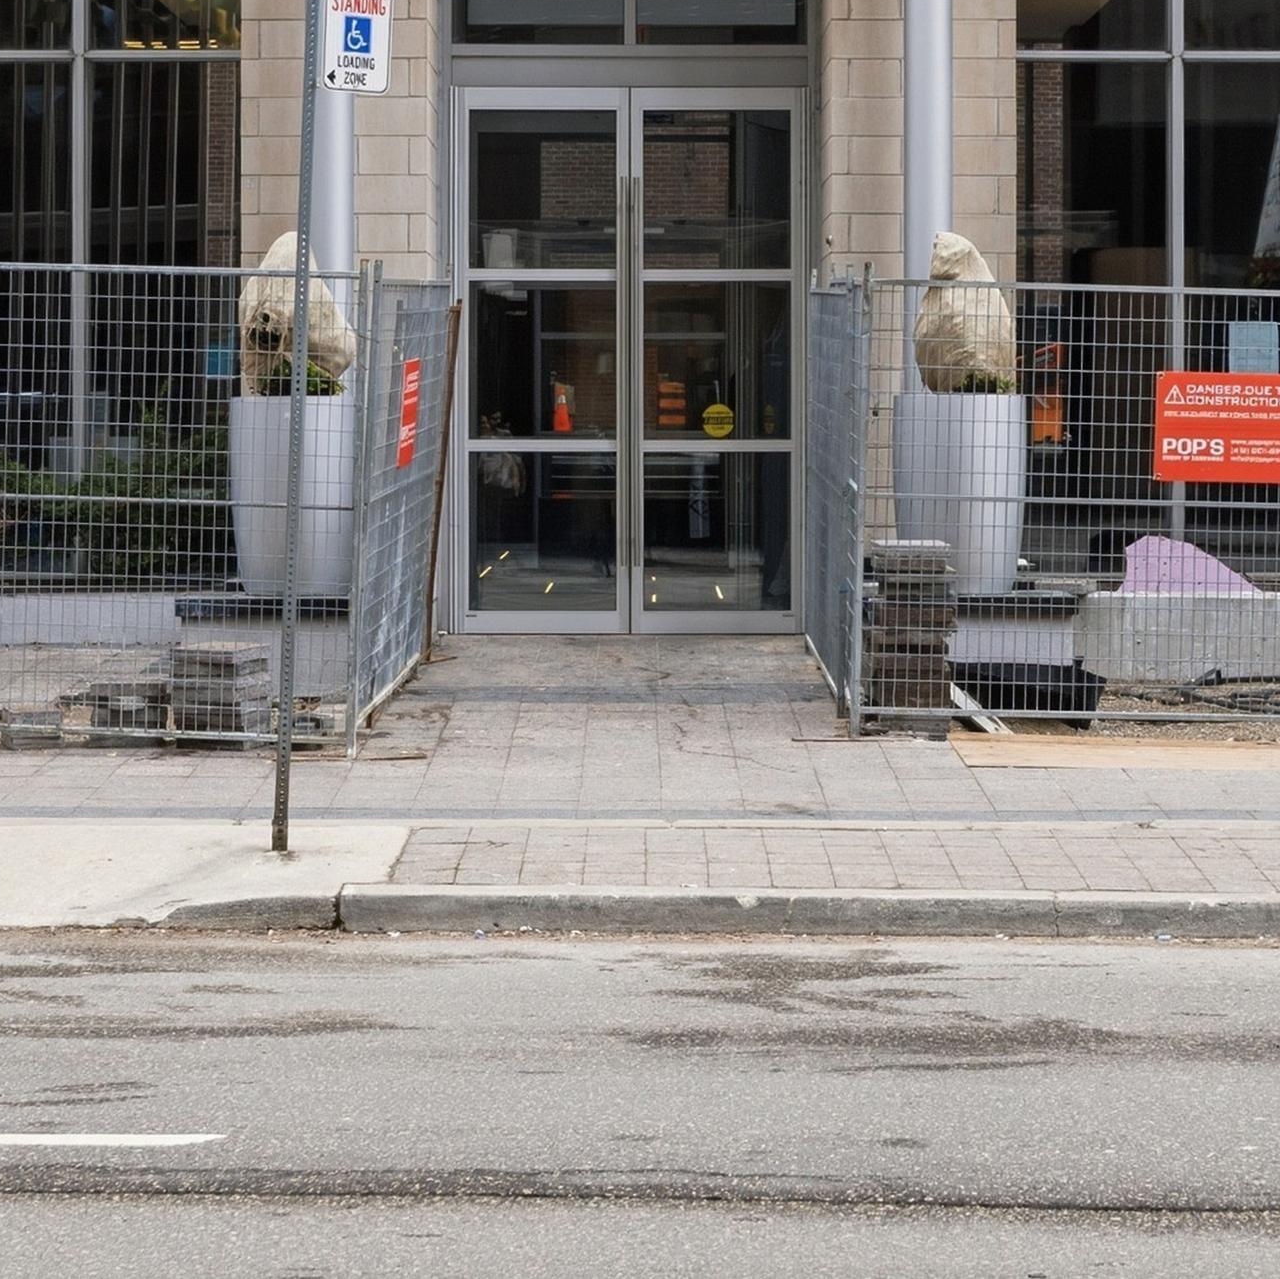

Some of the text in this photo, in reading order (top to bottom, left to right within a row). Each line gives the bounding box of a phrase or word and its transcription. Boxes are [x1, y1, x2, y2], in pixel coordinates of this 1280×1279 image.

[337, 55, 376, 70] LOADING
[343, 71, 368, 86] ZONE
[1186, 384, 1241, 395] DANGER
[1245, 385, 1273, 396] DUE
[1162, 437, 1225, 456] POP'S
